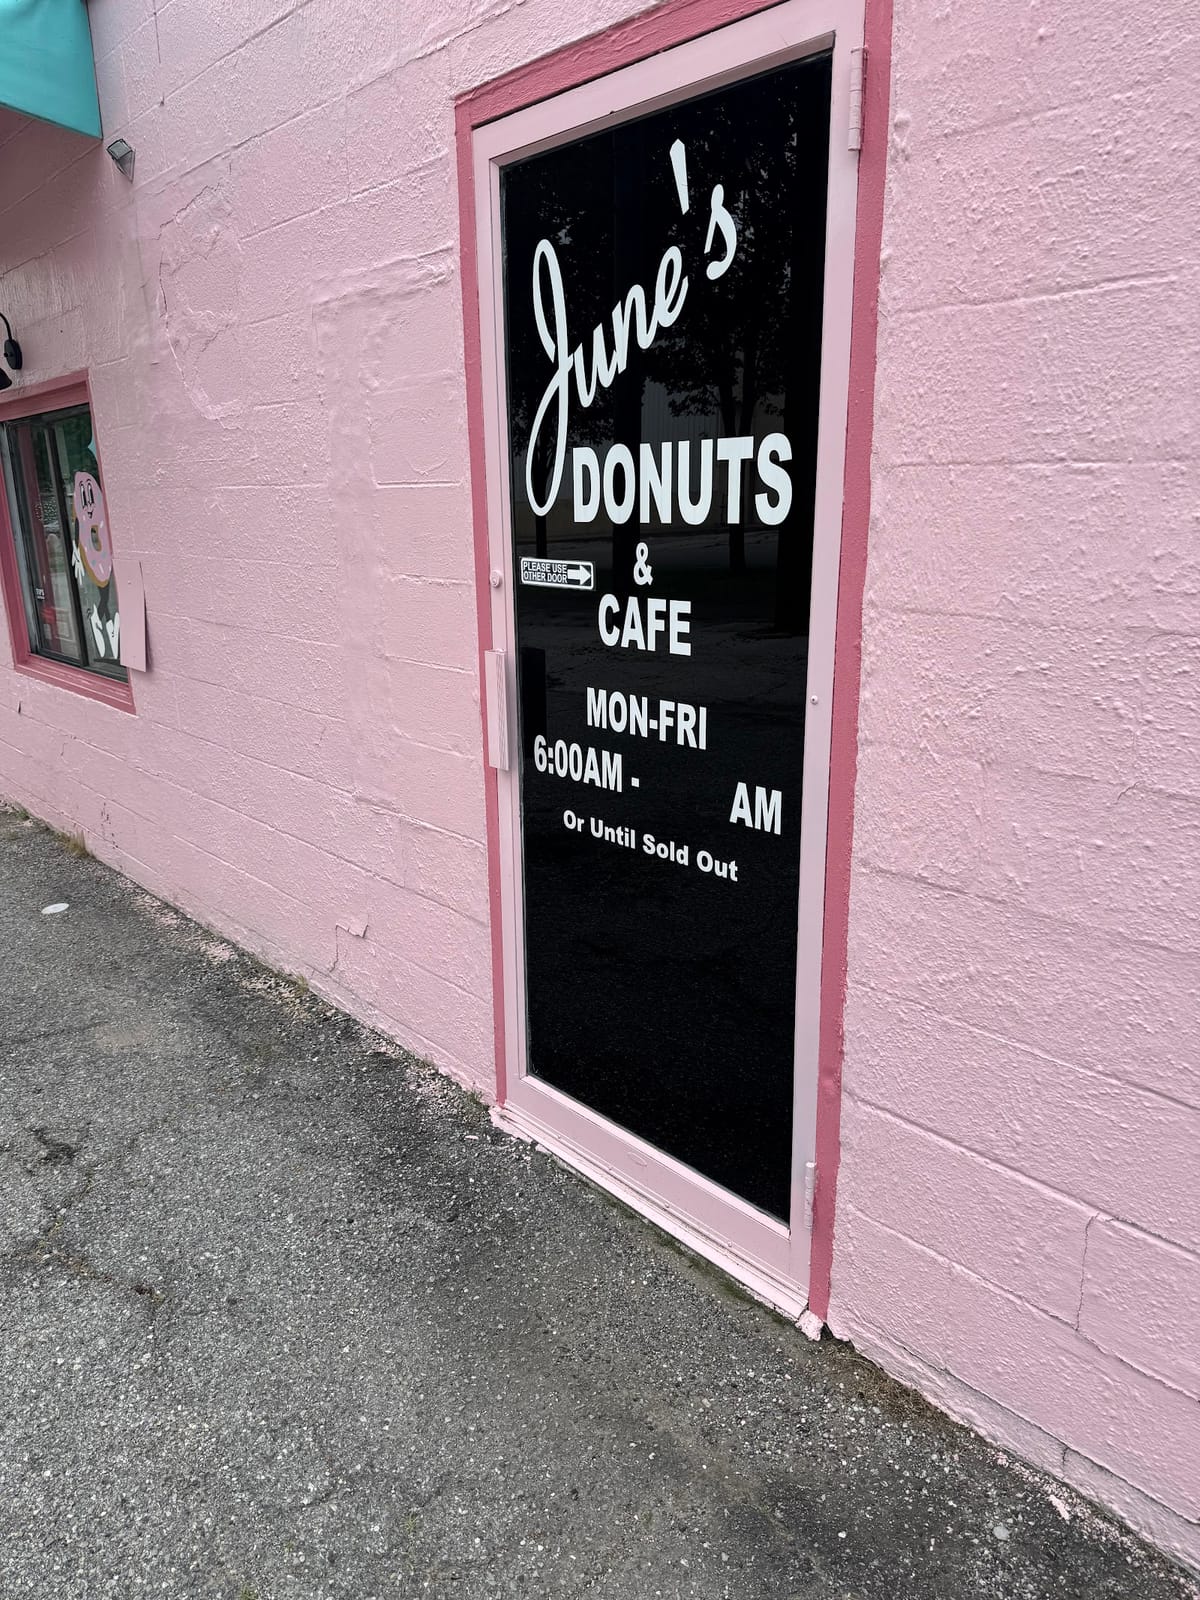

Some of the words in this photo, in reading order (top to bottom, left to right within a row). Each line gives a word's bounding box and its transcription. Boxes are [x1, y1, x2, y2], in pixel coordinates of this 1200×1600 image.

[526, 139, 737, 516] June's
[573, 433, 793, 526] DONUTS
[523, 562, 551, 573] PLEASE
[552, 564, 568, 574] USE
[524, 571, 546, 581] OTHER
[547, 573, 568, 584] DOOR
[634, 543, 653, 585] &
[599, 594, 691, 656] CAFE
[587, 686, 707, 750] MON-FRI
[534, 735, 622, 792] 6:00AM
[730, 782, 782, 835] AM
[564, 810, 584, 832] Or
[591, 817, 636, 849] Until
[643, 834, 689, 866] Sold
[697, 851, 738, 882] Out
